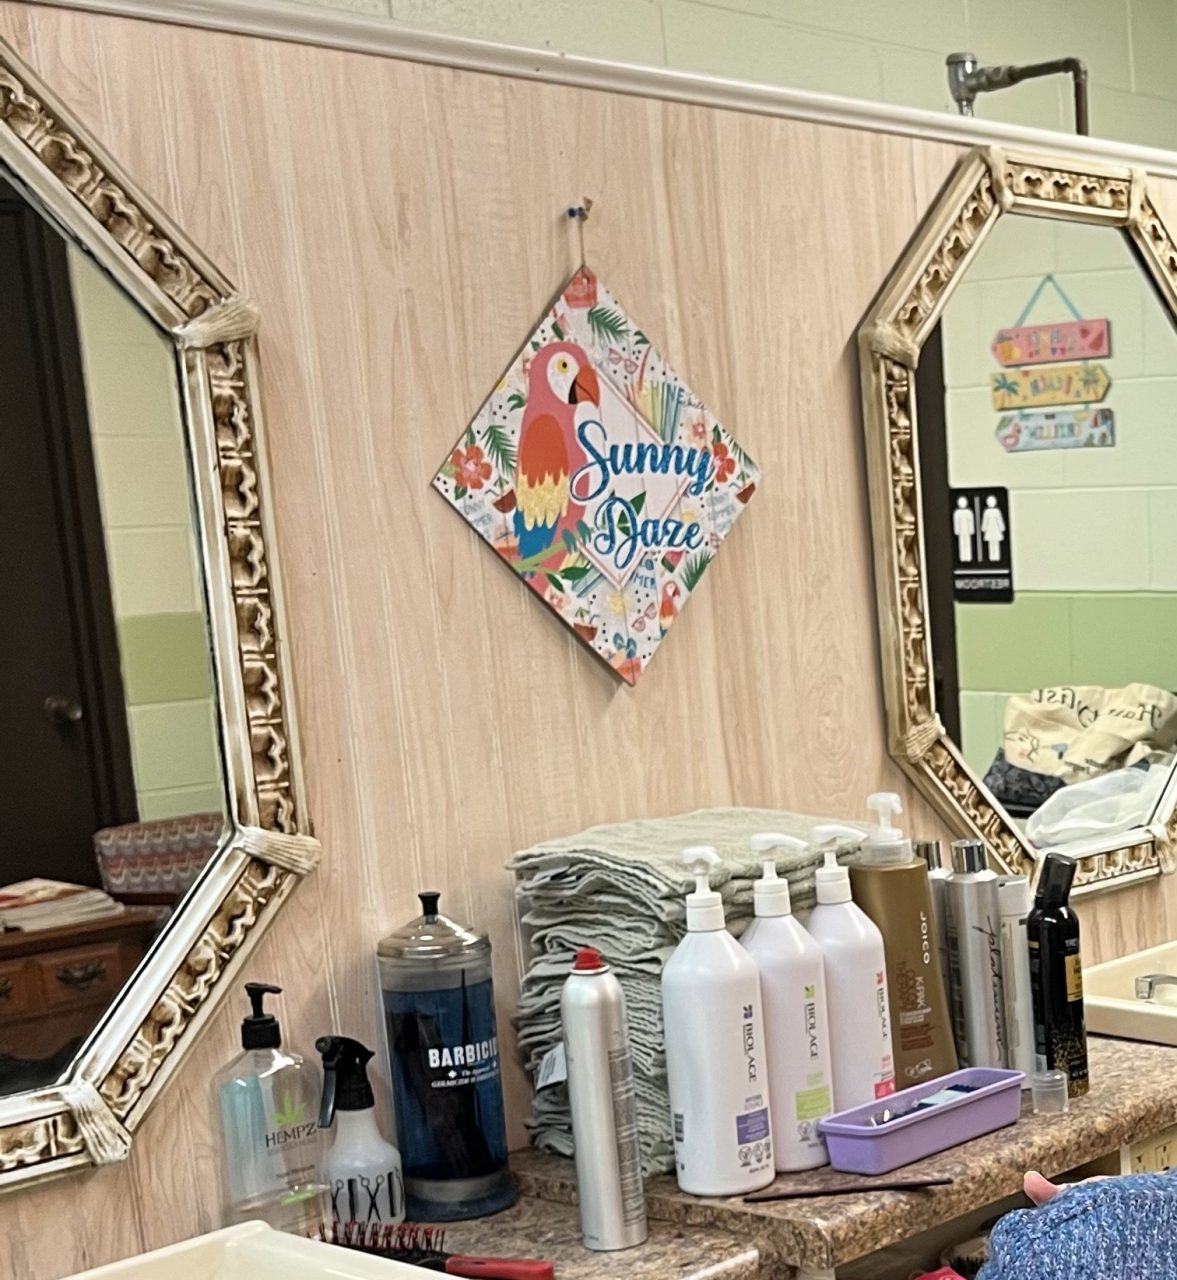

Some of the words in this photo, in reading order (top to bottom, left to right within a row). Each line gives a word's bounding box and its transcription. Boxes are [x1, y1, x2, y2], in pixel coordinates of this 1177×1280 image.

[569, 419, 715, 502] Sunny
[594, 495, 704, 570] Daze
[920, 911, 931, 964] JOICO
[744, 1022, 757, 1083] BIOLAGE
[806, 1002, 819, 1060] BIOLAGE
[265, 1121, 317, 1148] HEMPZ
